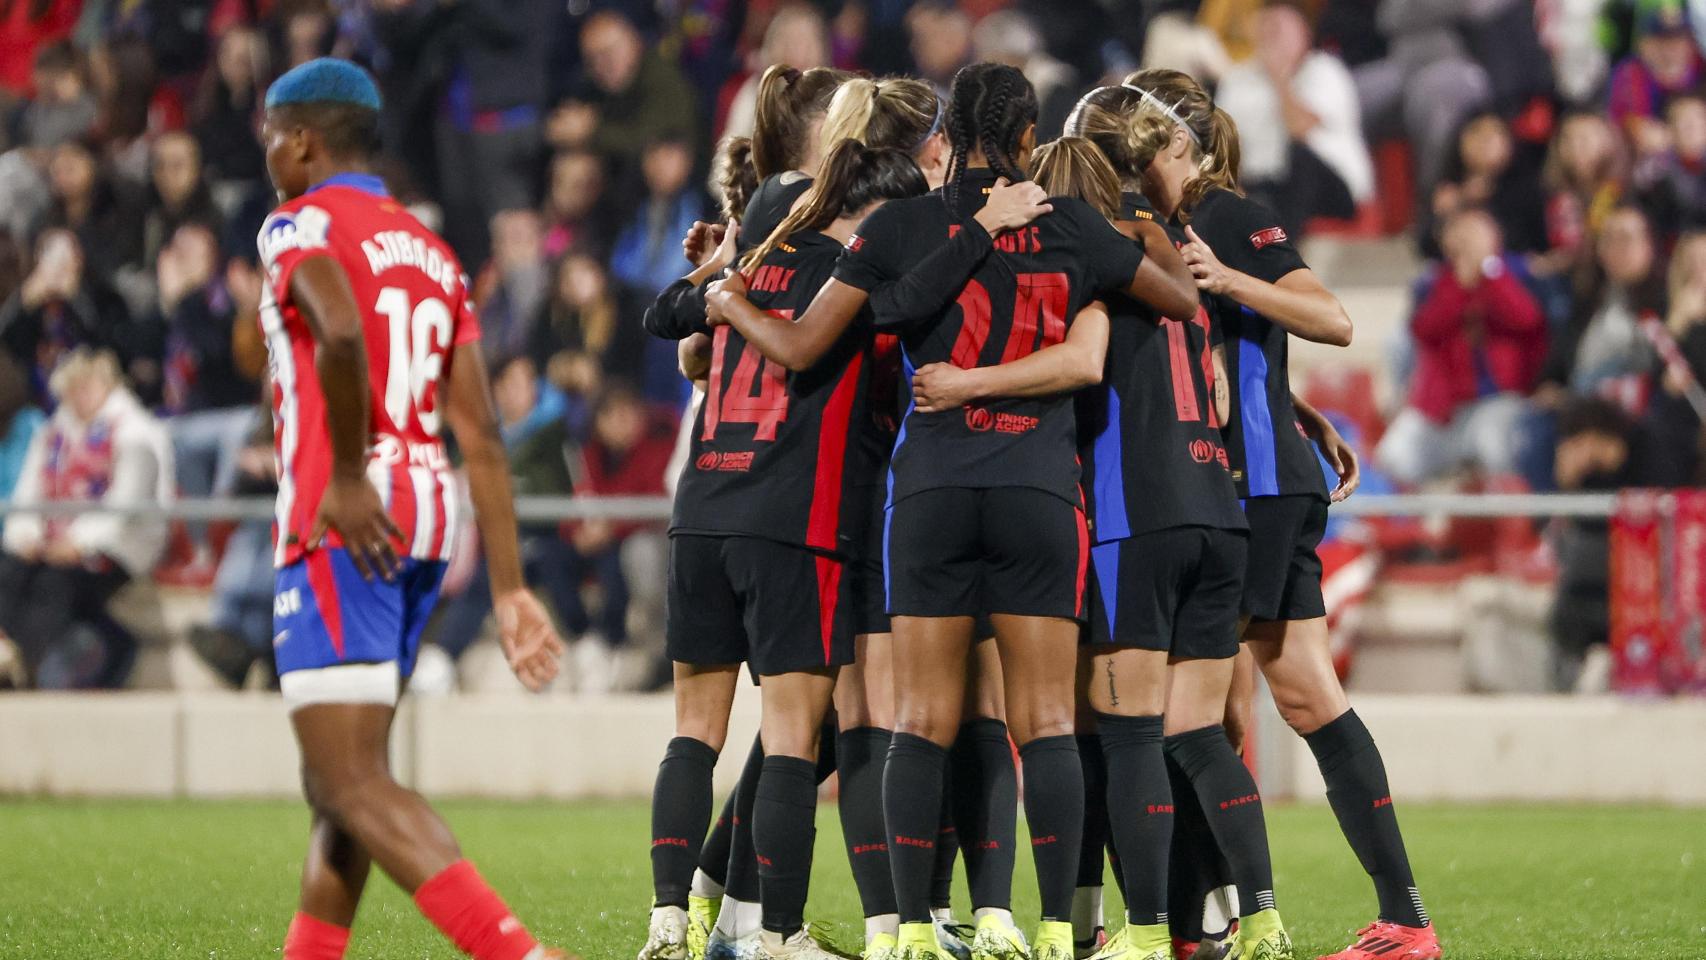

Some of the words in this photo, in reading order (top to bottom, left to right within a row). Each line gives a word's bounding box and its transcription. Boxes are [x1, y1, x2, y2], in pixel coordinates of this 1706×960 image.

[360, 230, 457, 296] AJIBADE
[374, 287, 454, 436] 16
[701, 308, 796, 441] 14
